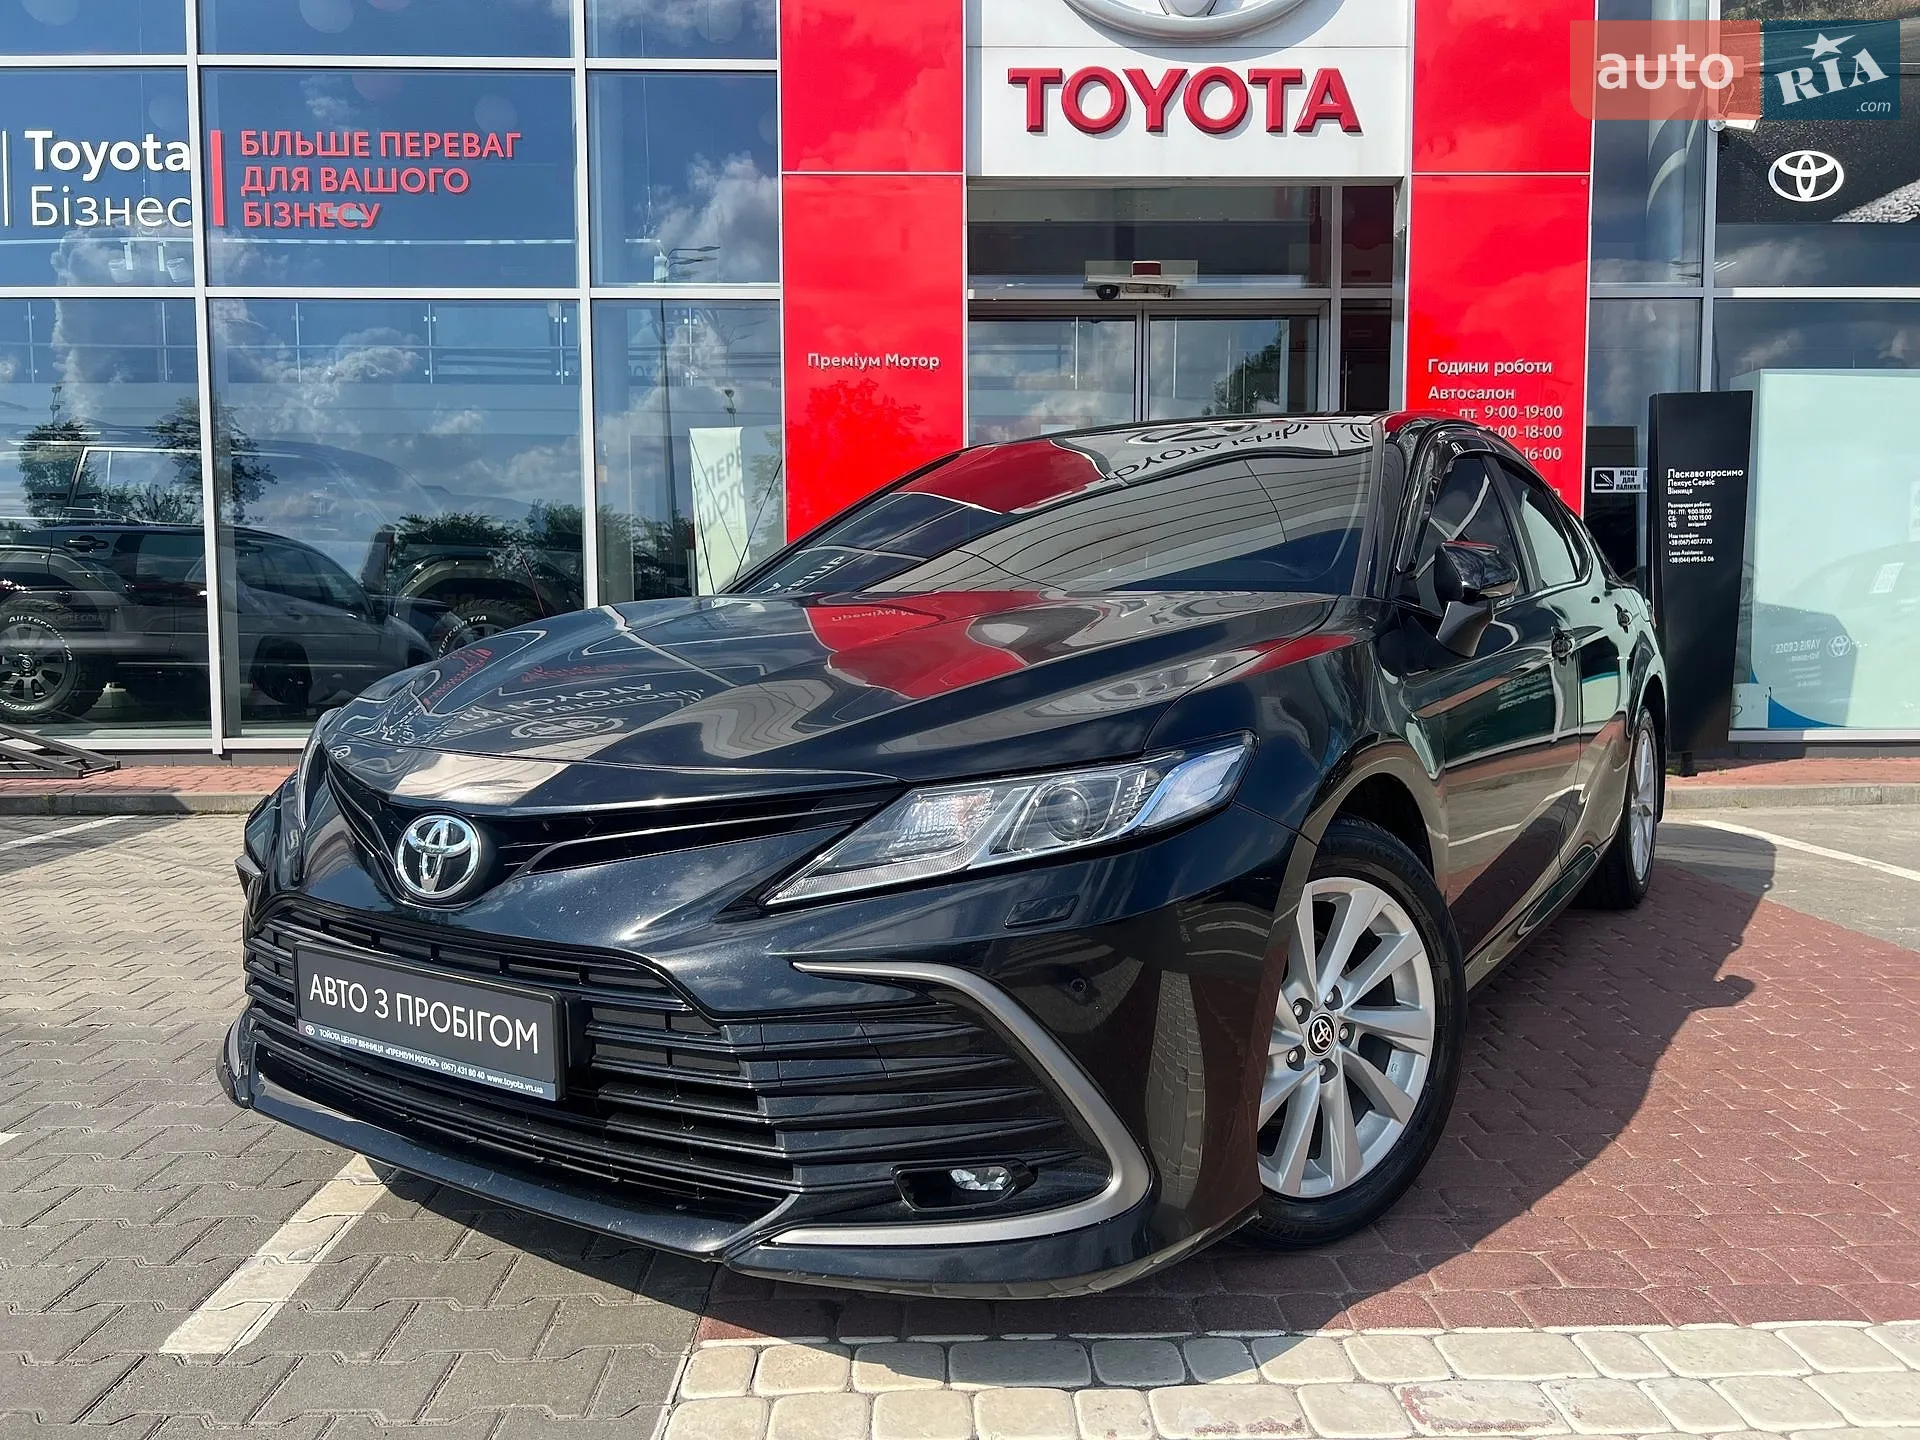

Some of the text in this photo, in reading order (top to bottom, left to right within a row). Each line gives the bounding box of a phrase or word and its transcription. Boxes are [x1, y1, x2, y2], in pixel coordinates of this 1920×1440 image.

[1008, 66, 1363, 133] TOYOTA
[24, 130, 190, 181] Toyota
[241, 130, 521, 158] БІЛЬШЕ ПЕРЕВАГ
[240, 166, 470, 197] ДЛЯ ВАШОГО
[31, 185, 192, 227] Бізнес
[243, 202, 380, 228] БІЗНЕСУ
[807, 352, 940, 370] Преміум Мотор
[1427, 358, 1552, 376] Години роботи
[1428, 386, 1515, 400] Автосалон
[1484, 405, 1563, 419] 9:00-19:00
[1705, 470, 1744, 479] просимо
[309, 973, 368, 1013] АВТО
[396, 992, 538, 1055] ПРОБІГОМ
[318, 1028, 341, 1042] ТОЙОТА
[341, 1035, 358, 1046] ЦЕНТР
[359, 1039, 384, 1054] ВІННИЦЯ
[441, 1061, 457, 1074] (067)
[456, 1065, 468, 1076] 431
[468, 1068, 477, 1078] 80
[476, 1070, 486, 1080] 40
[486, 1073, 544, 1095] www.toyota.vn.ua
